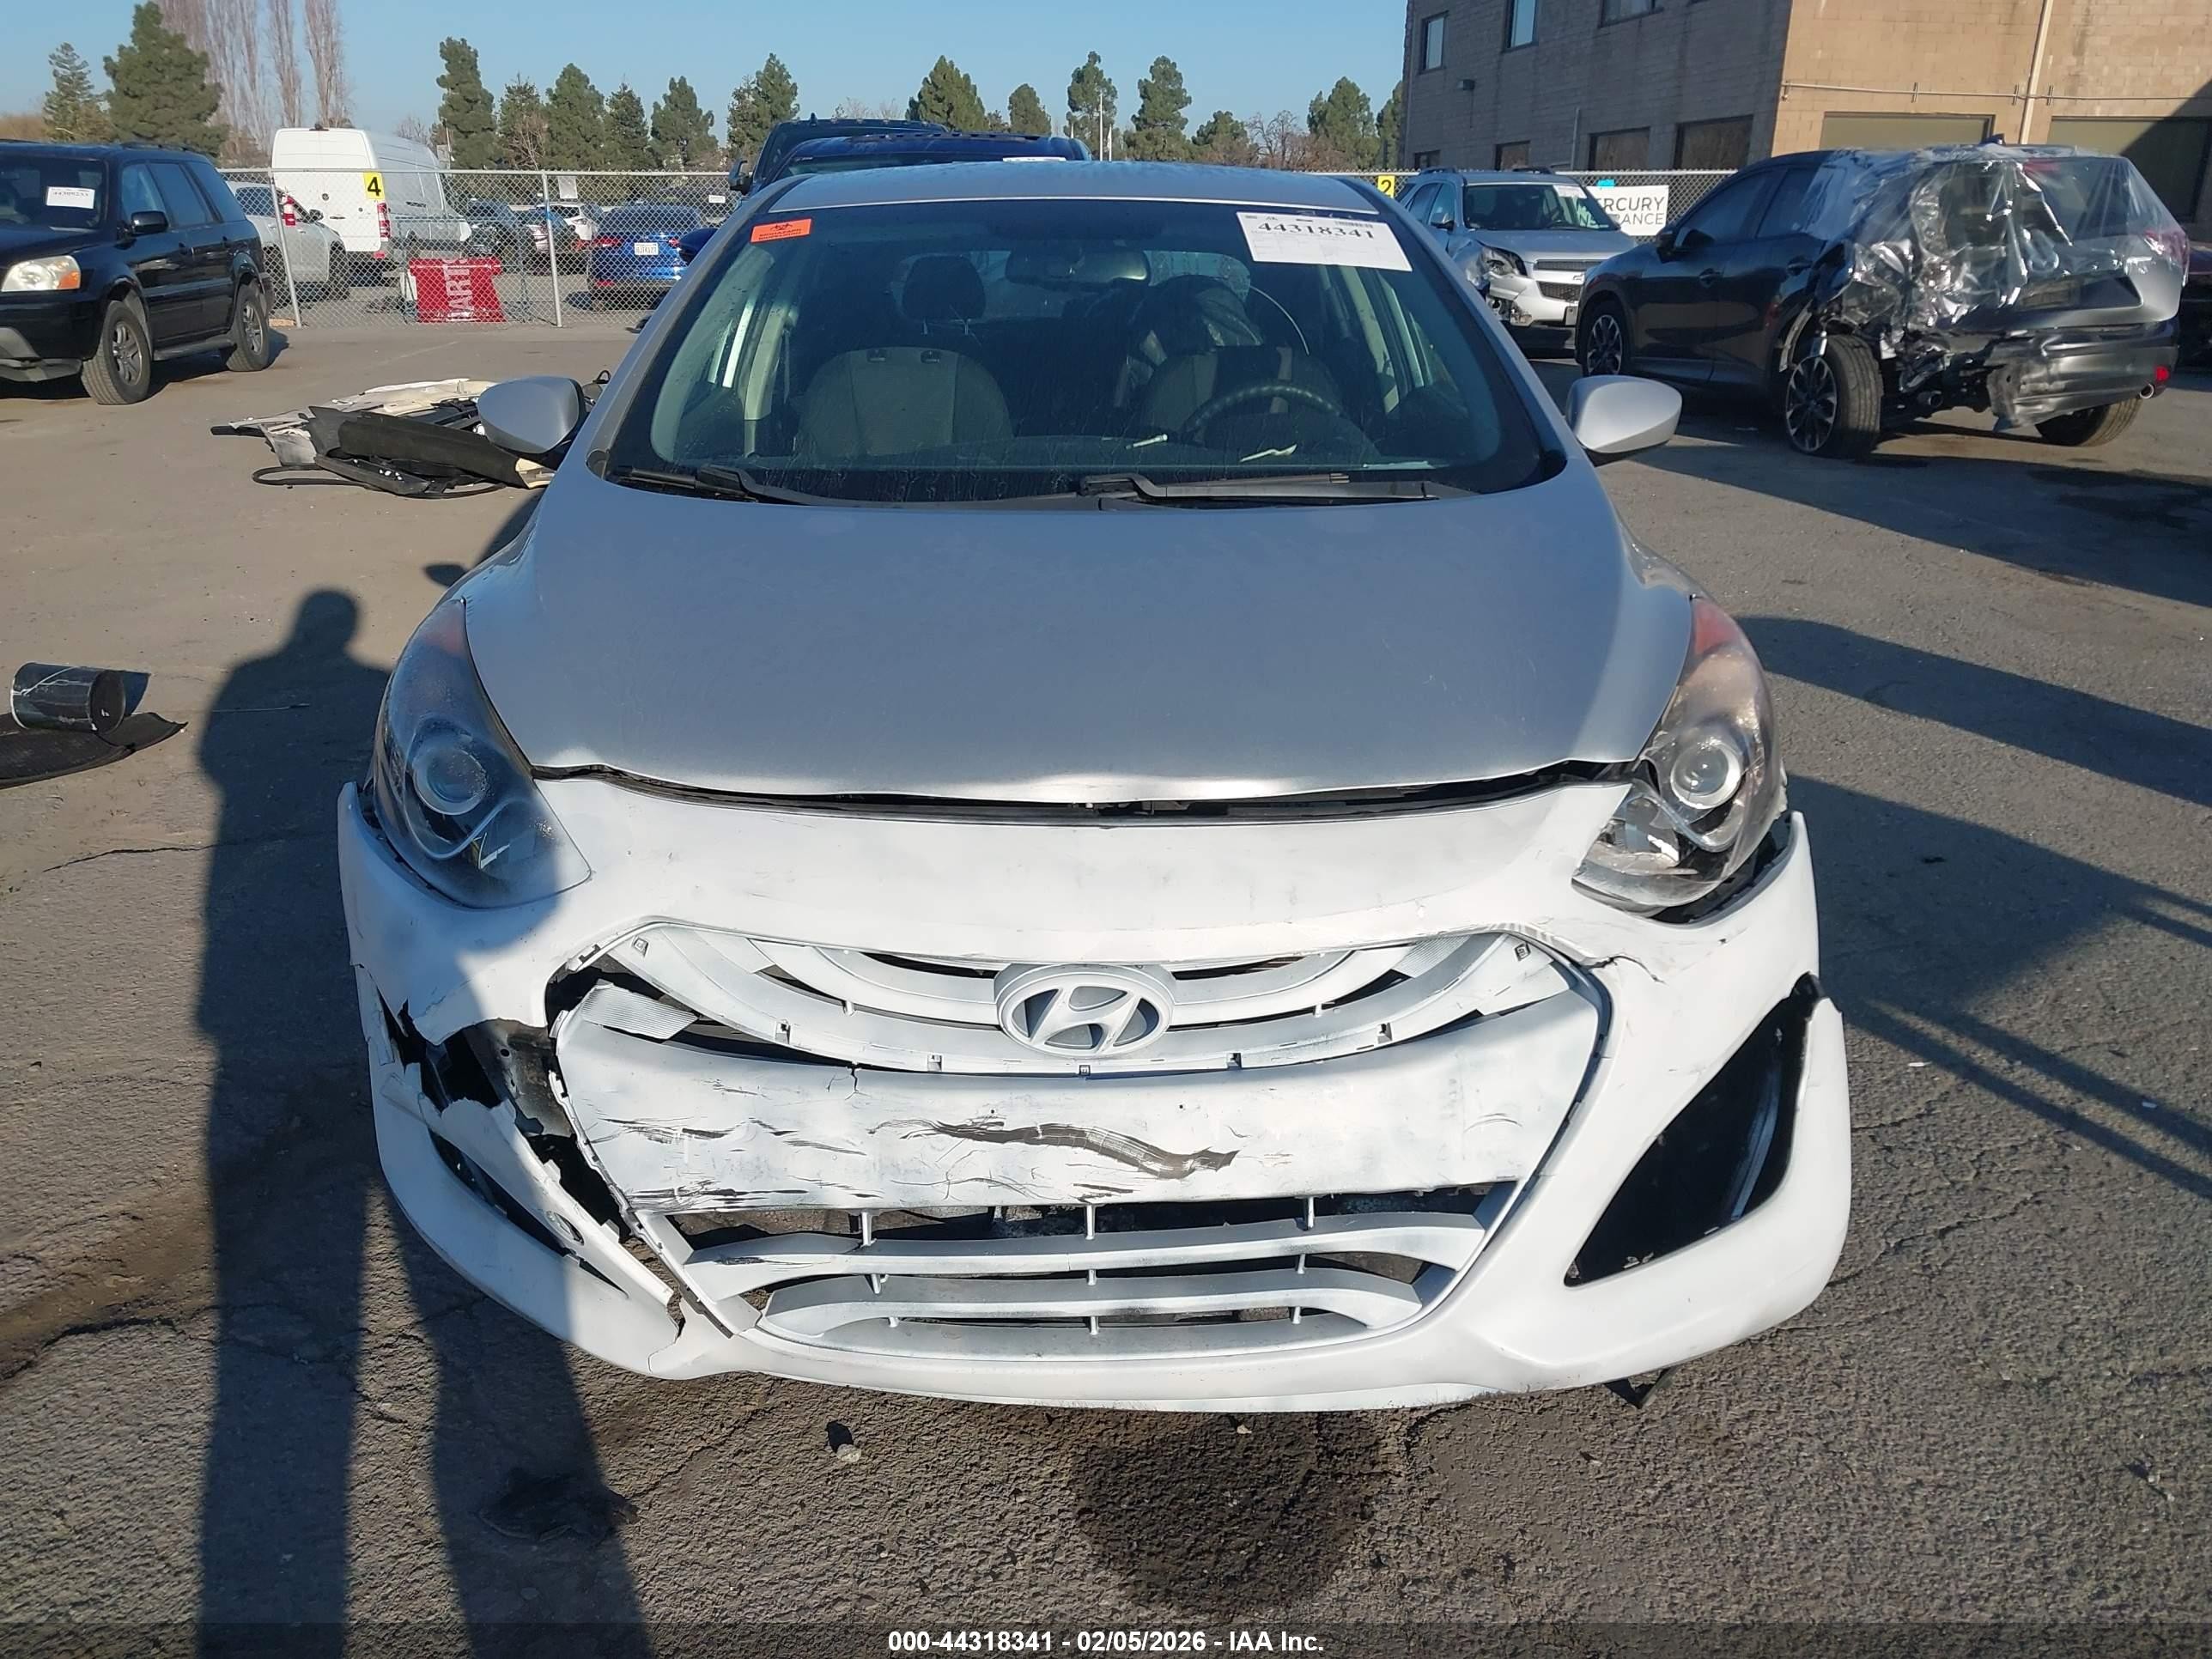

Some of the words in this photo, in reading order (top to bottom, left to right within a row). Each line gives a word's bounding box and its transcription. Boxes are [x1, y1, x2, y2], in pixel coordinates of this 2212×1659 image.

[368, 176, 381, 197] 4
[1381, 179, 1392, 193] 2
[1258, 222, 1374, 239] 44318341
